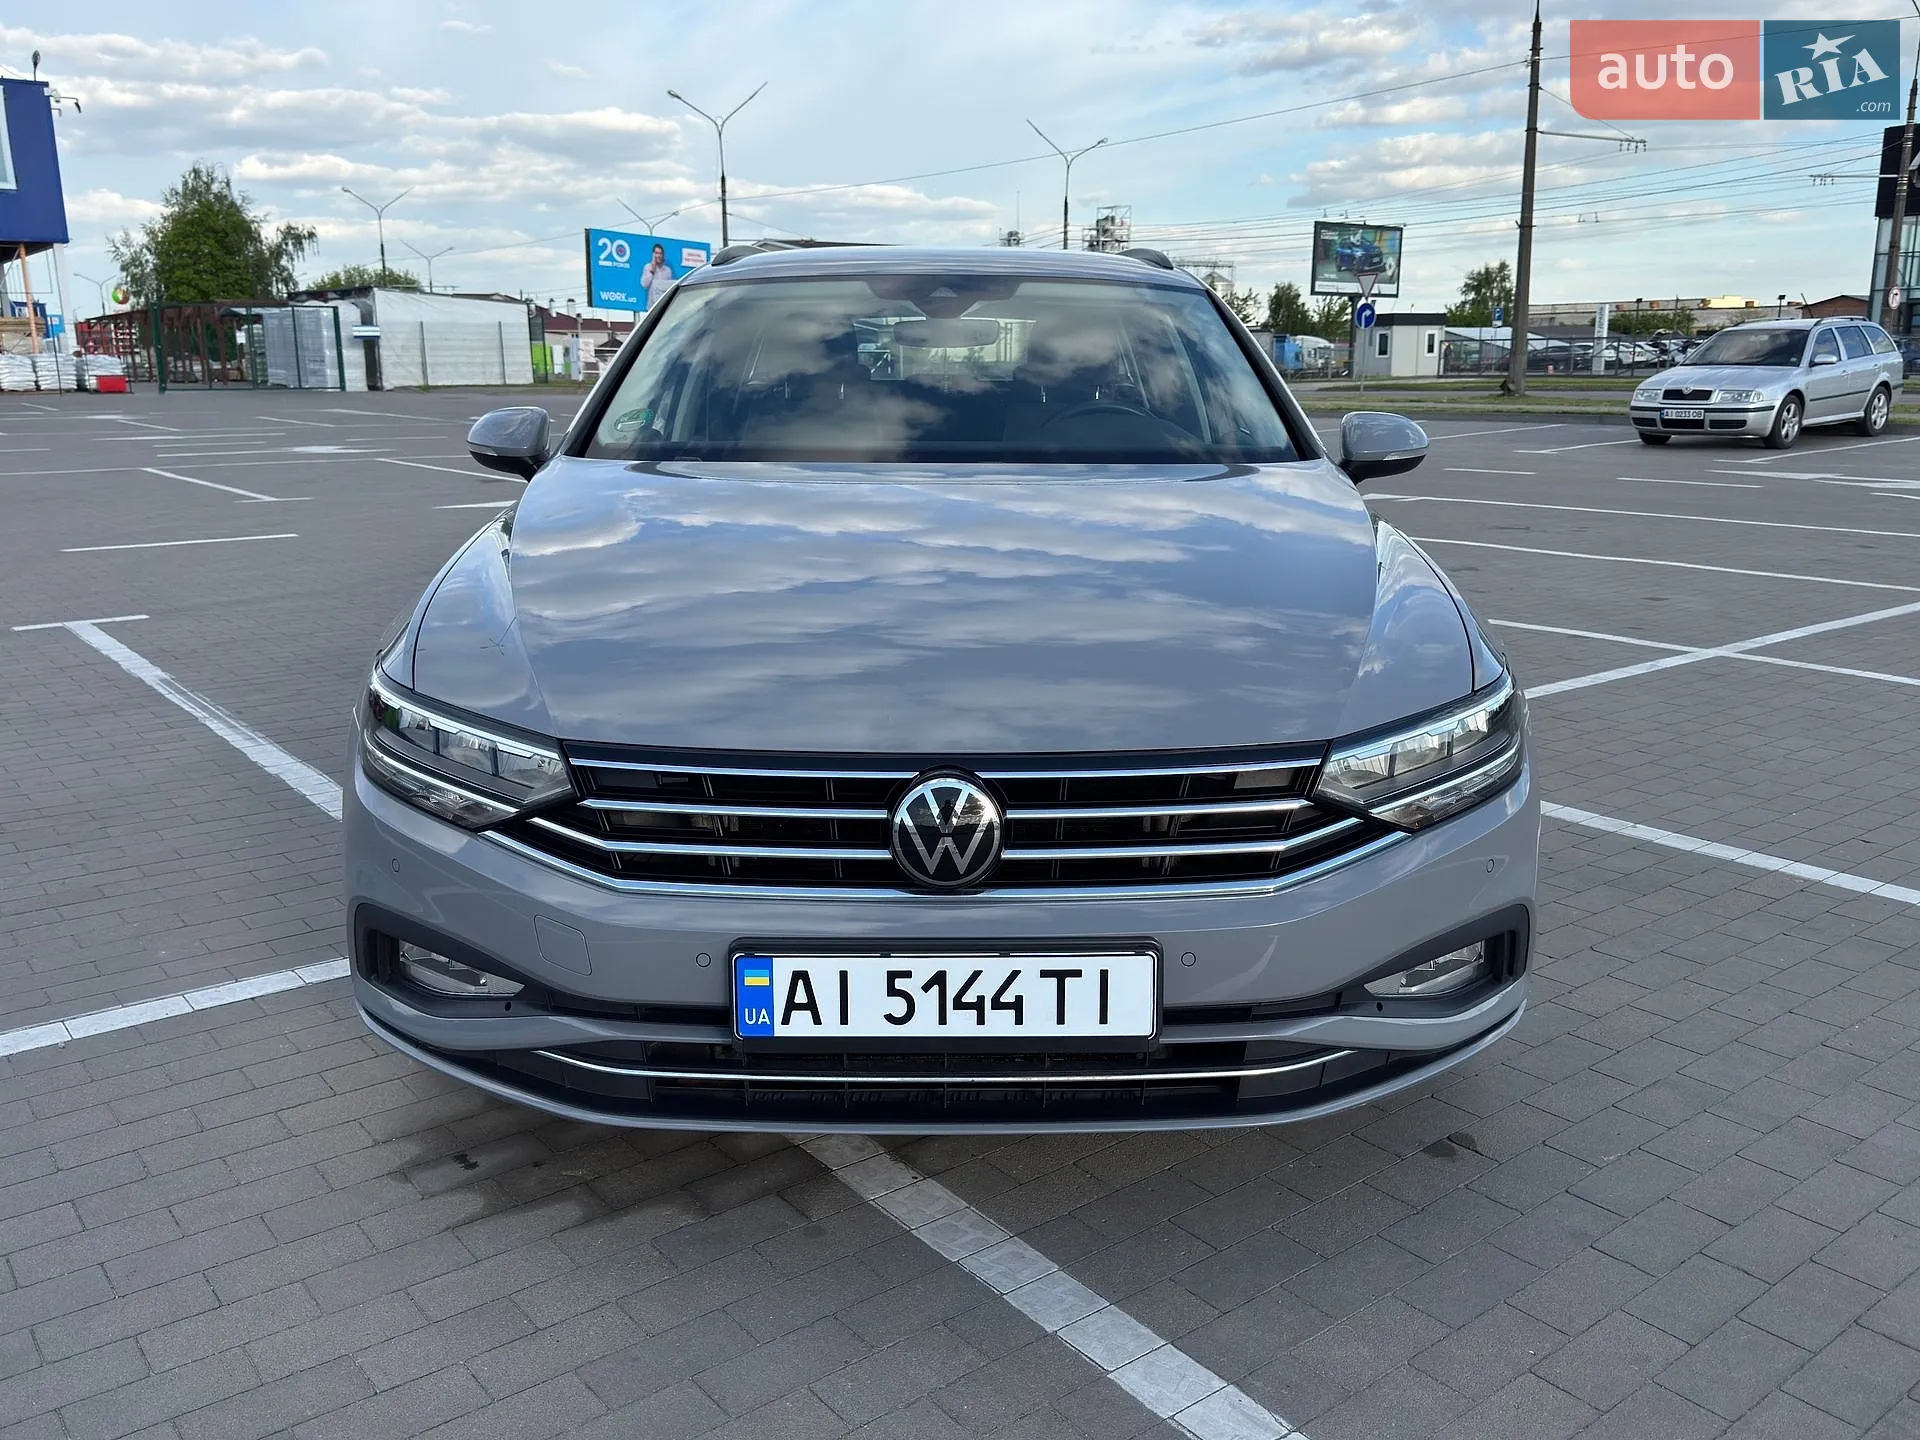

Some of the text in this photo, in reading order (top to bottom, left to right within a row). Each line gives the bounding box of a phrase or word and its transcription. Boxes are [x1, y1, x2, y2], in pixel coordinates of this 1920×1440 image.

[598, 237, 631, 262] 20
[780, 968, 1109, 1026] AI 5144 TI
[744, 1007, 771, 1025] UA
